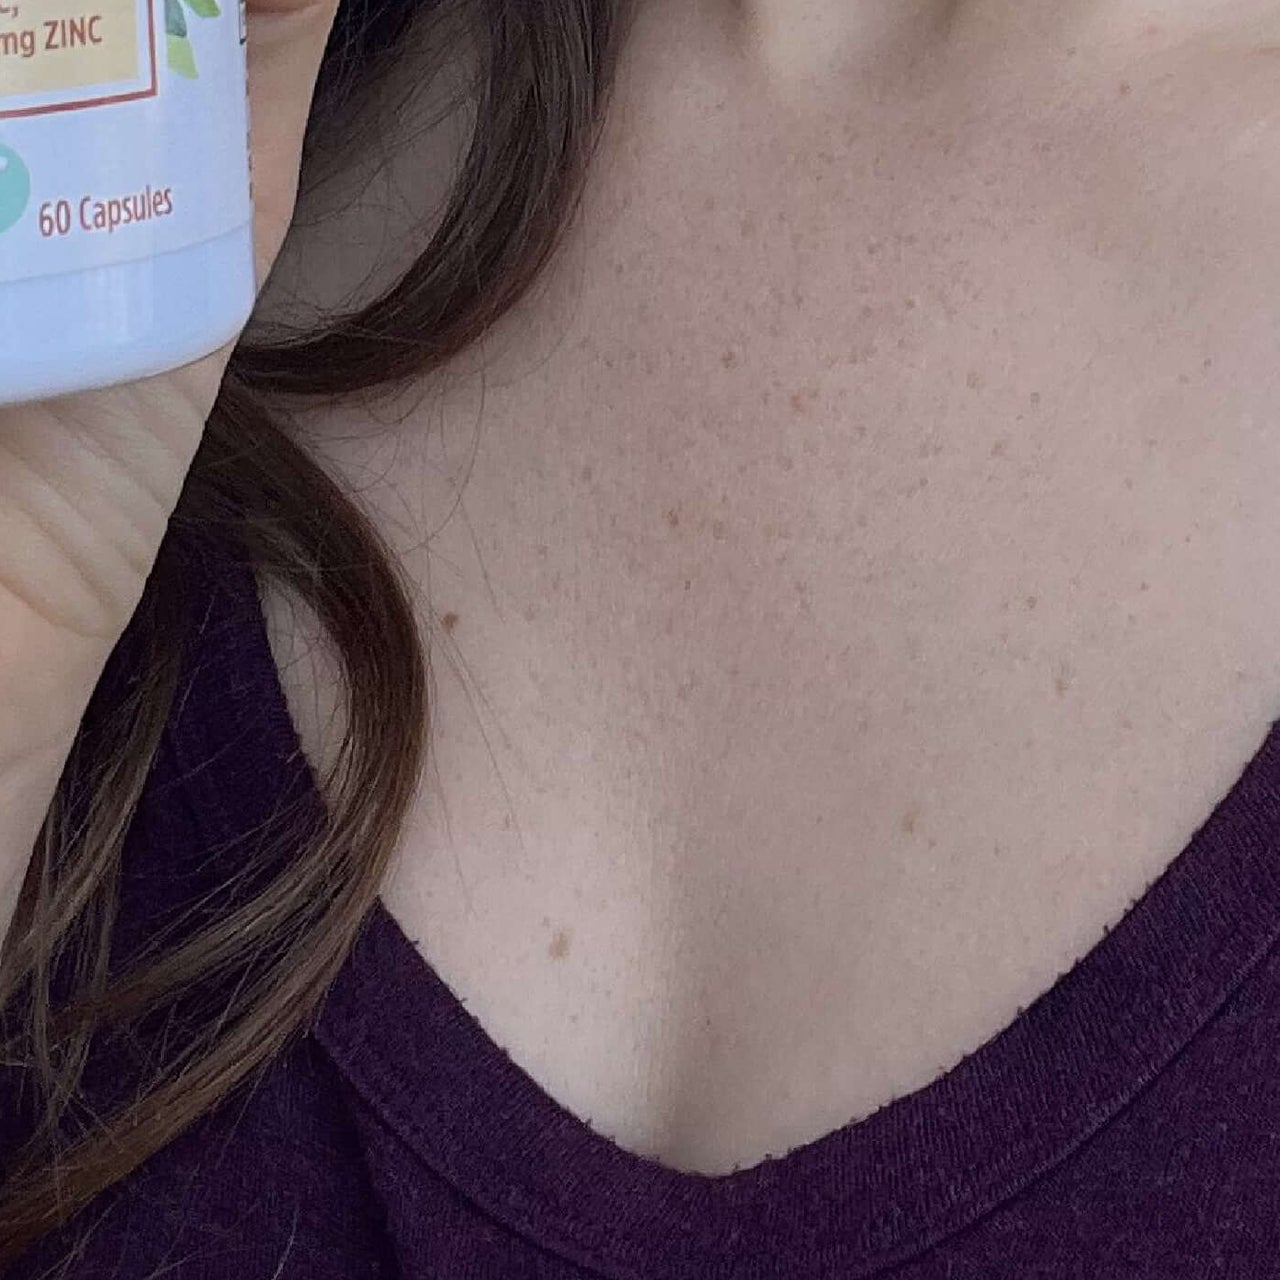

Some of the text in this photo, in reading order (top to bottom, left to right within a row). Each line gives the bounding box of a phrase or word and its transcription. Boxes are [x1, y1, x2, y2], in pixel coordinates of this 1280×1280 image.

[44, 16, 102, 49] ZINC
[39, 185, 173, 237] 60 Capsules
